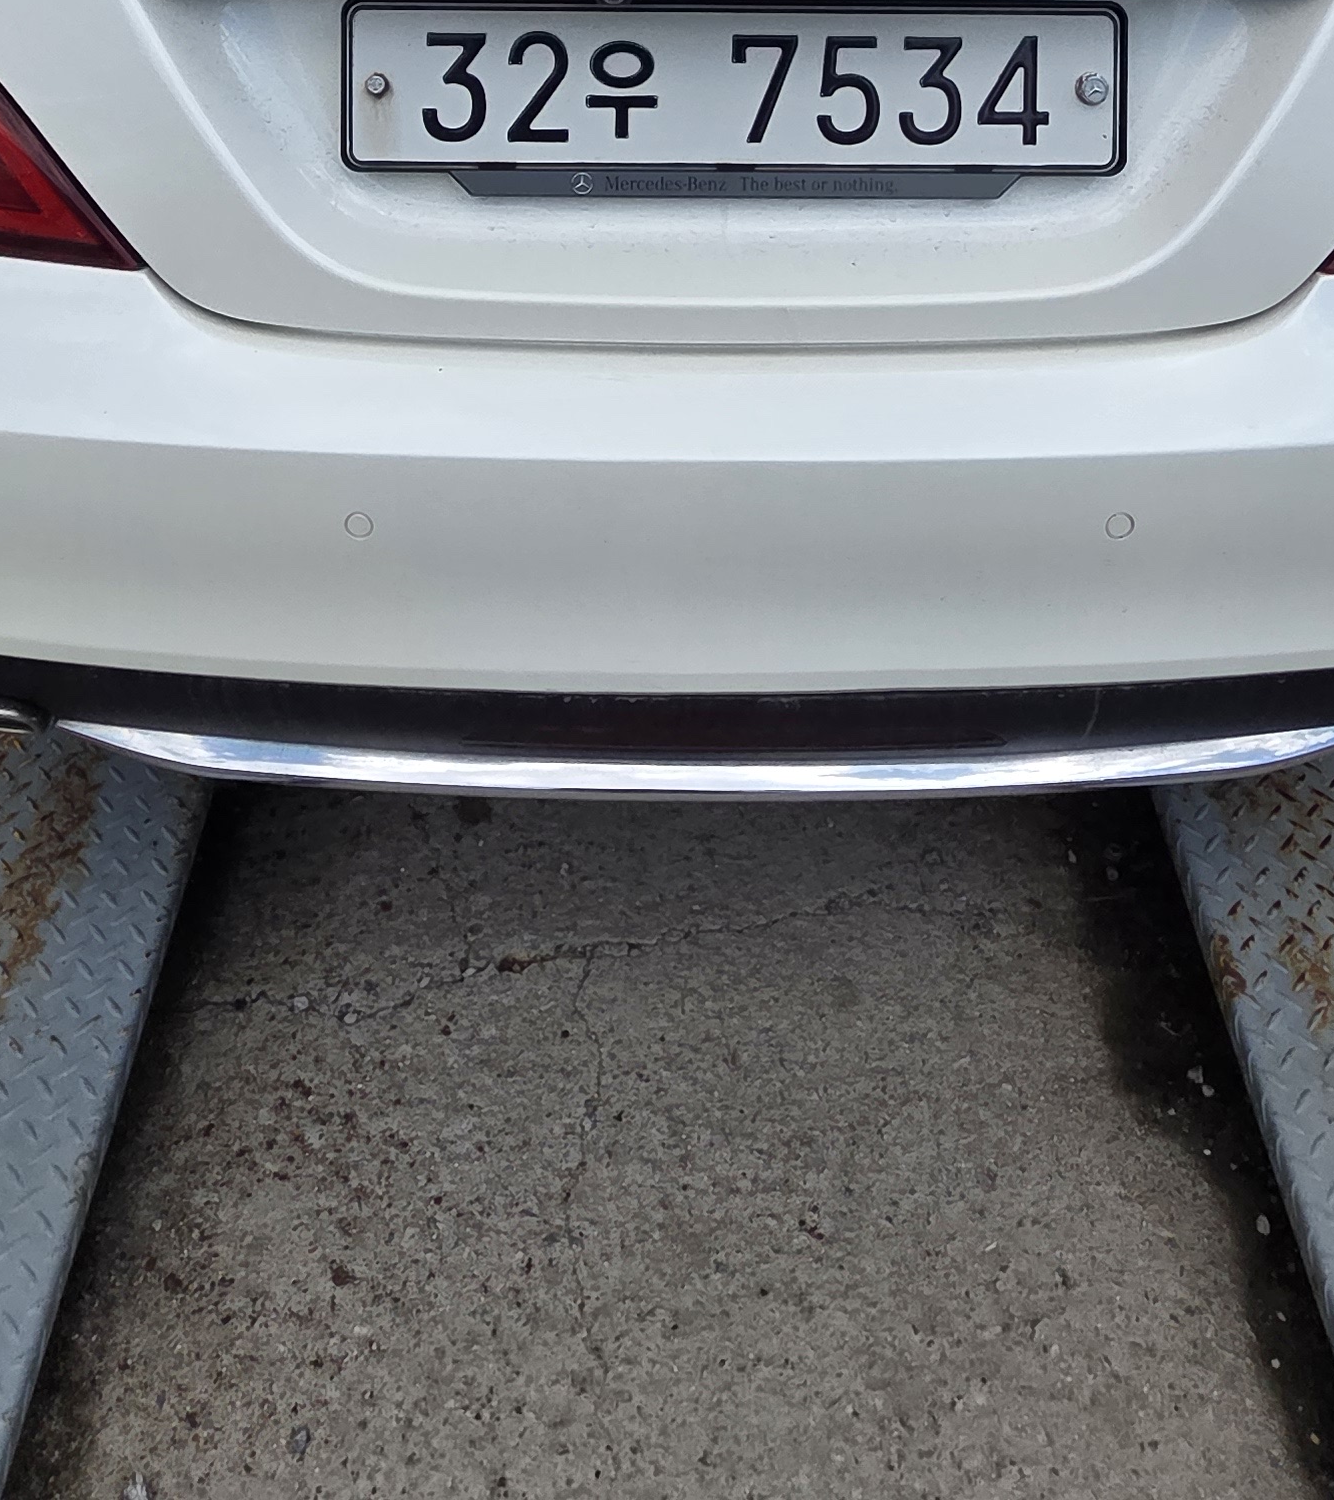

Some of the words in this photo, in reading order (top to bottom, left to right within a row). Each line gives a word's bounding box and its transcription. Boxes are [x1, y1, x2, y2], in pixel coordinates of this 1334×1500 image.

[421, 31, 659, 143] 32우
[731, 34, 1050, 145] 7534
[605, 175, 727, 192] Mercedes-Benz
[740, 176, 769, 192] The
[774, 176, 807, 192] best
[812, 180, 828, 192] or
